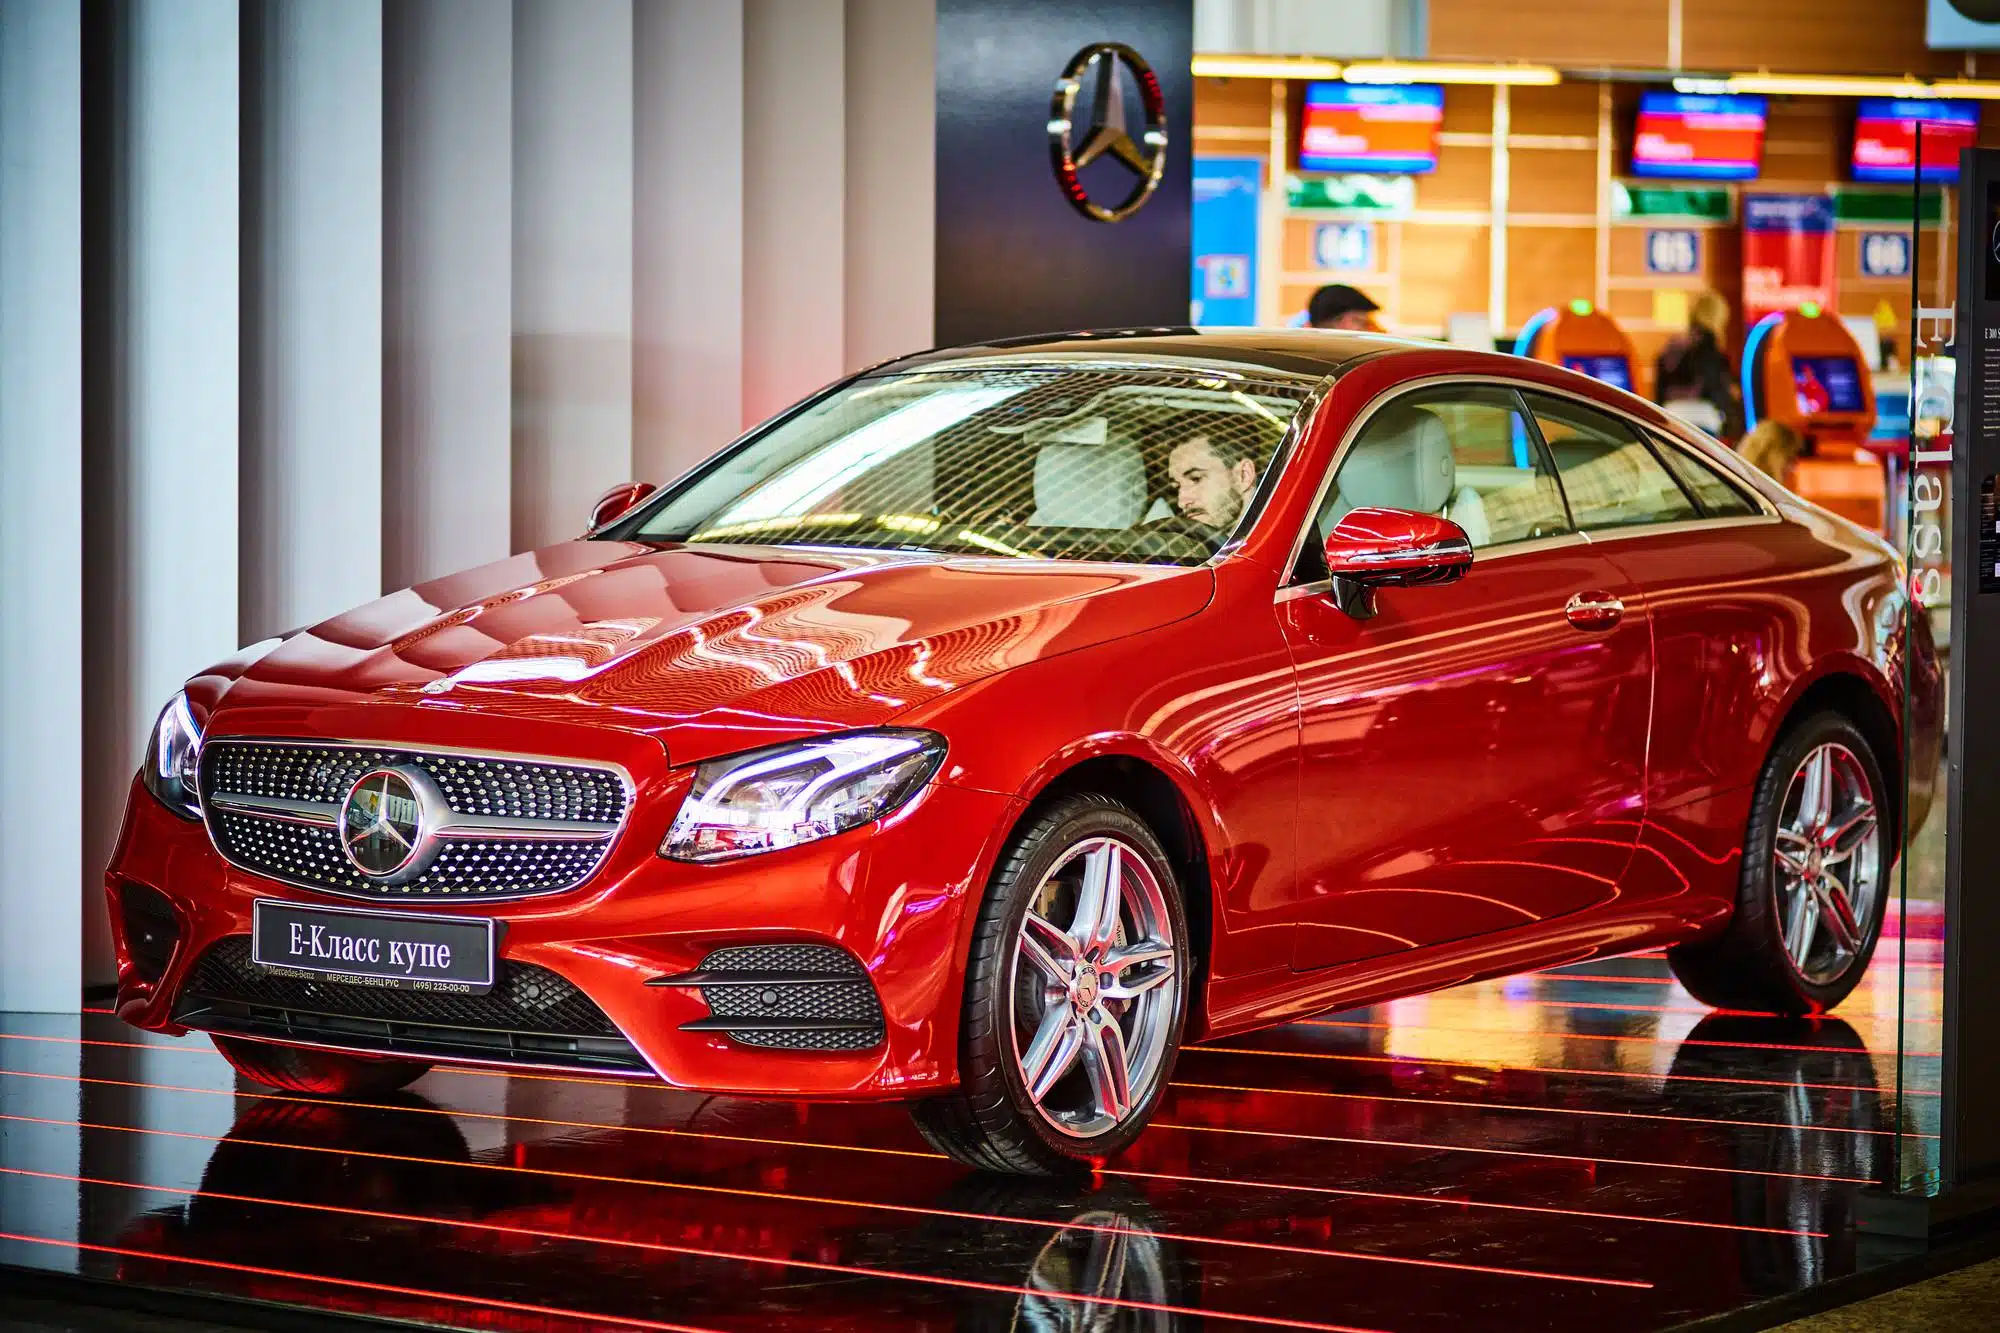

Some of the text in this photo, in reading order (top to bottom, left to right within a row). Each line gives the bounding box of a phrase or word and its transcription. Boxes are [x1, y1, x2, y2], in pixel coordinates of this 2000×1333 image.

[289, 922, 451, 974] Е-Класс купе
[268, 965, 315, 980] Mercedes-Benz
[326, 973, 470, 993] МЕРСЕДЕС-БЕНЦ РУС (495) 225-00-00
